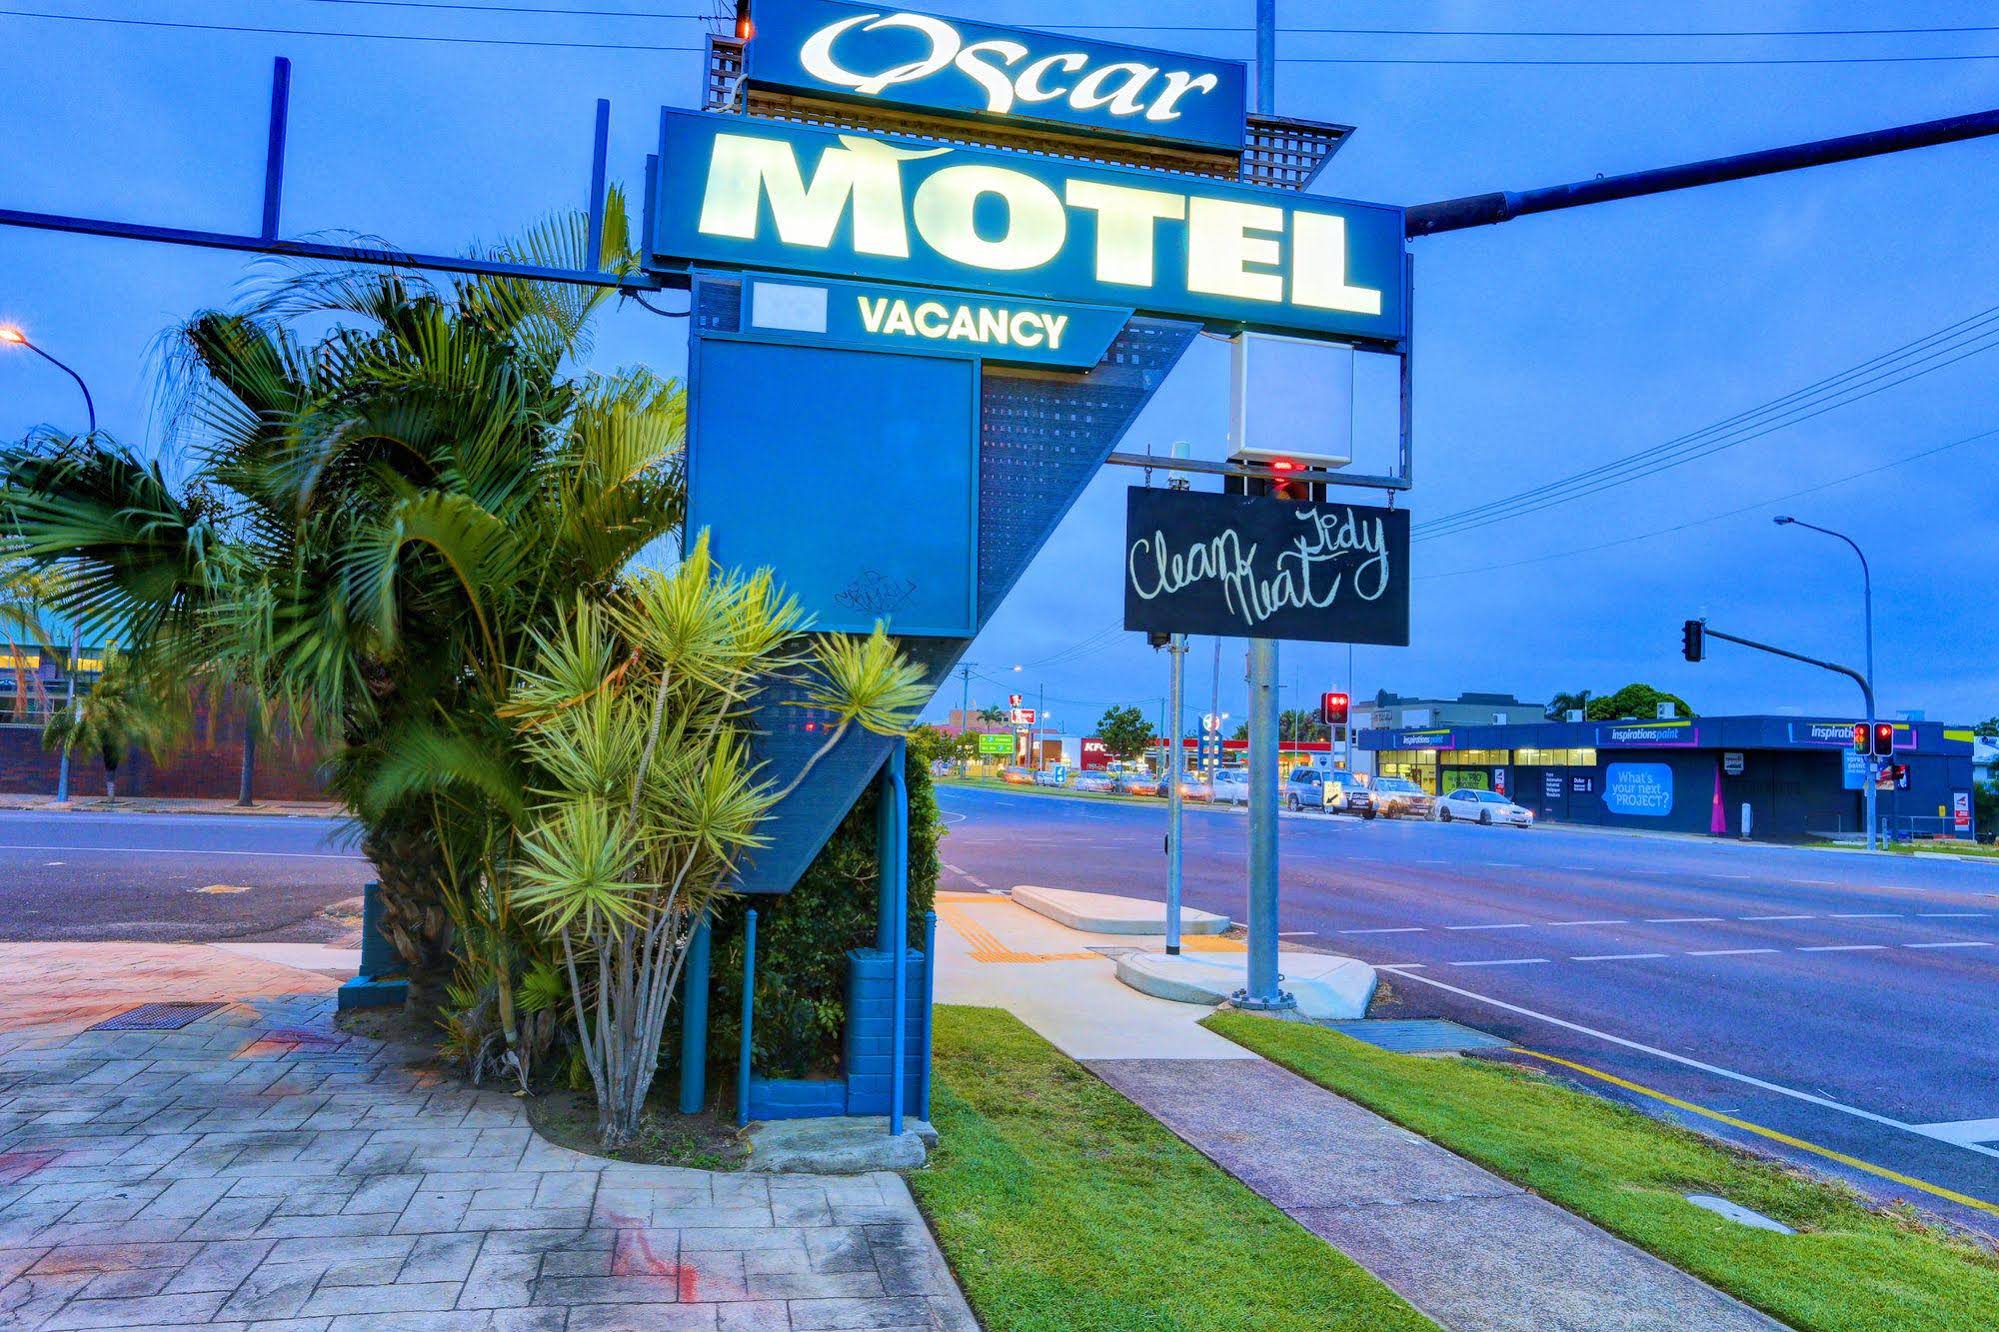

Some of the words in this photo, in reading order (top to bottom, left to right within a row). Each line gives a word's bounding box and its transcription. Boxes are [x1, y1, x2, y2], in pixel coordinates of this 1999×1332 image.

[800, 13, 1218, 122] Oscar
[698, 133, 1382, 316] MOTEL
[857, 295, 1068, 350] VACANCY
[1130, 529, 1256, 600] Clean
[1225, 536, 1350, 625] Neat
[1295, 507, 1390, 601] Tidy
[1084, 742, 1108, 752] KFC
[1618, 770, 1653, 784] What's
[1612, 784, 1636, 795] your
[1638, 784, 1661, 794] next
[1617, 792, 1670, 808] PROJECT?
